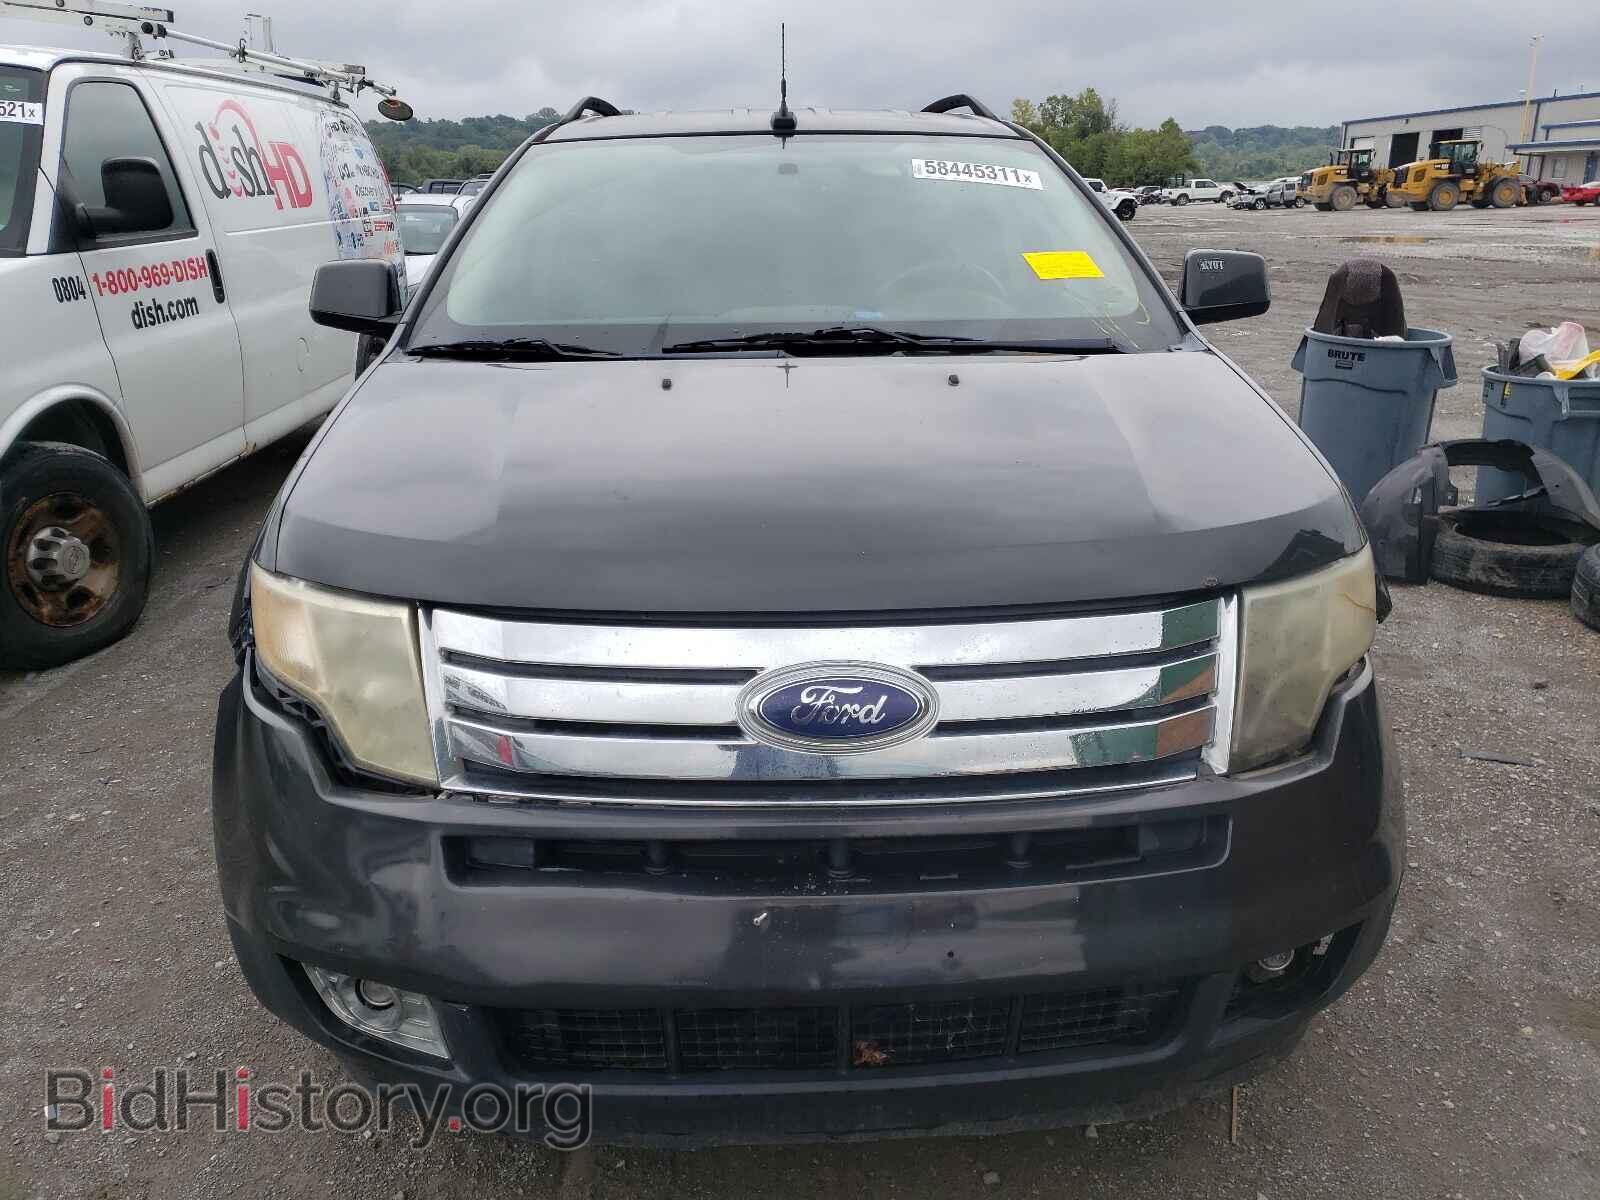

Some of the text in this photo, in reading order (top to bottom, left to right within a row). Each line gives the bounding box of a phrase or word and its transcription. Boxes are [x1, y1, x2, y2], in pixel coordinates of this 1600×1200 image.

[52, 264, 86, 303] 0804
[131, 297, 199, 330] dish.com
[1327, 349, 1366, 362] BRUTE
[791, 685, 888, 725] Ford
